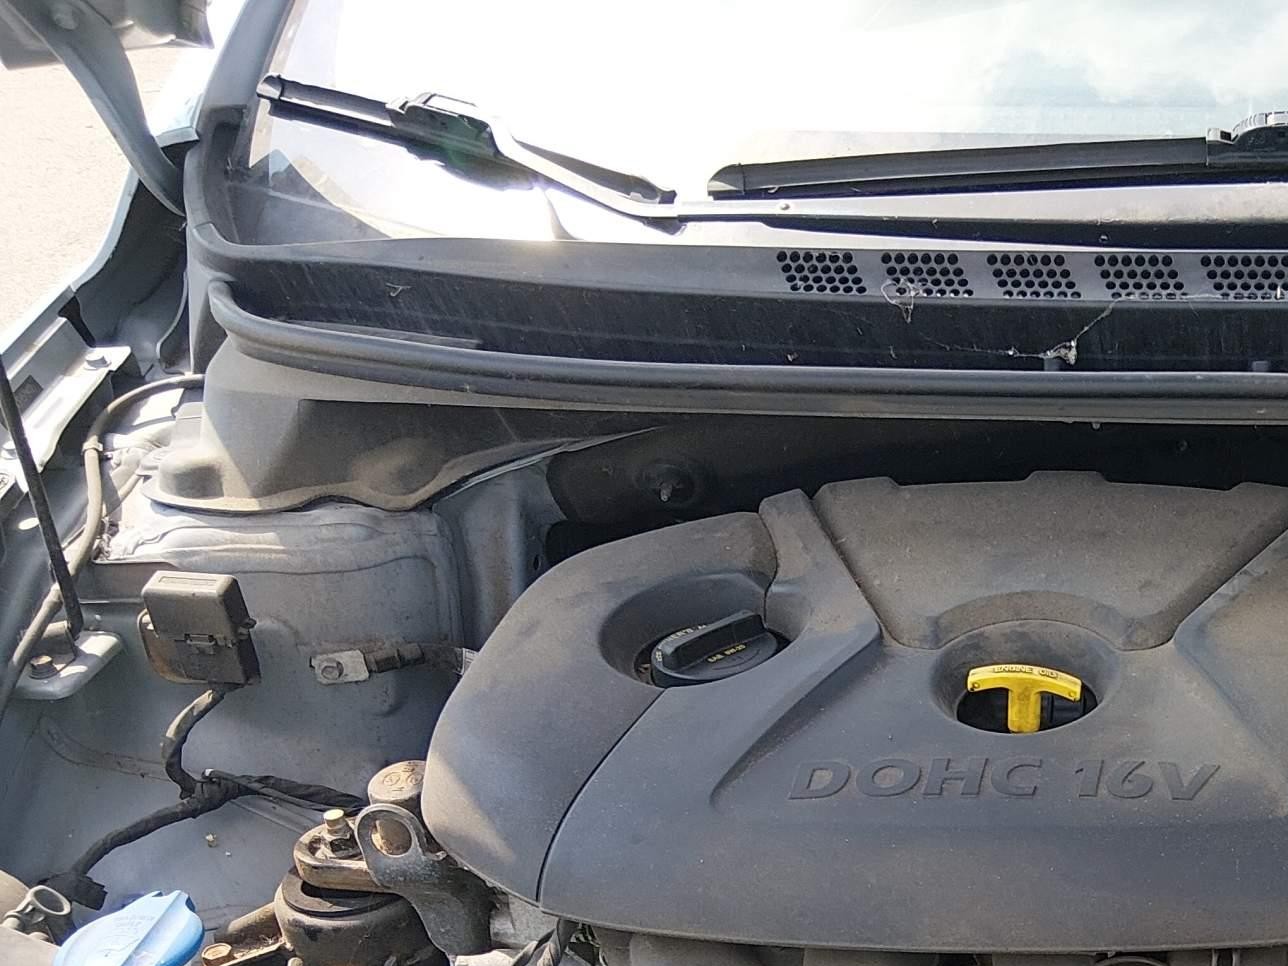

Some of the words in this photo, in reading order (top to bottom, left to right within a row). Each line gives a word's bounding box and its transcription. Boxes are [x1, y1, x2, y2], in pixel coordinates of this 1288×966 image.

[995, 665, 1033, 673] ENGINE
[1039, 668, 1057, 678] OIL
[787, 756, 1043, 800] DOHC
[1074, 758, 1221, 801] 16V
